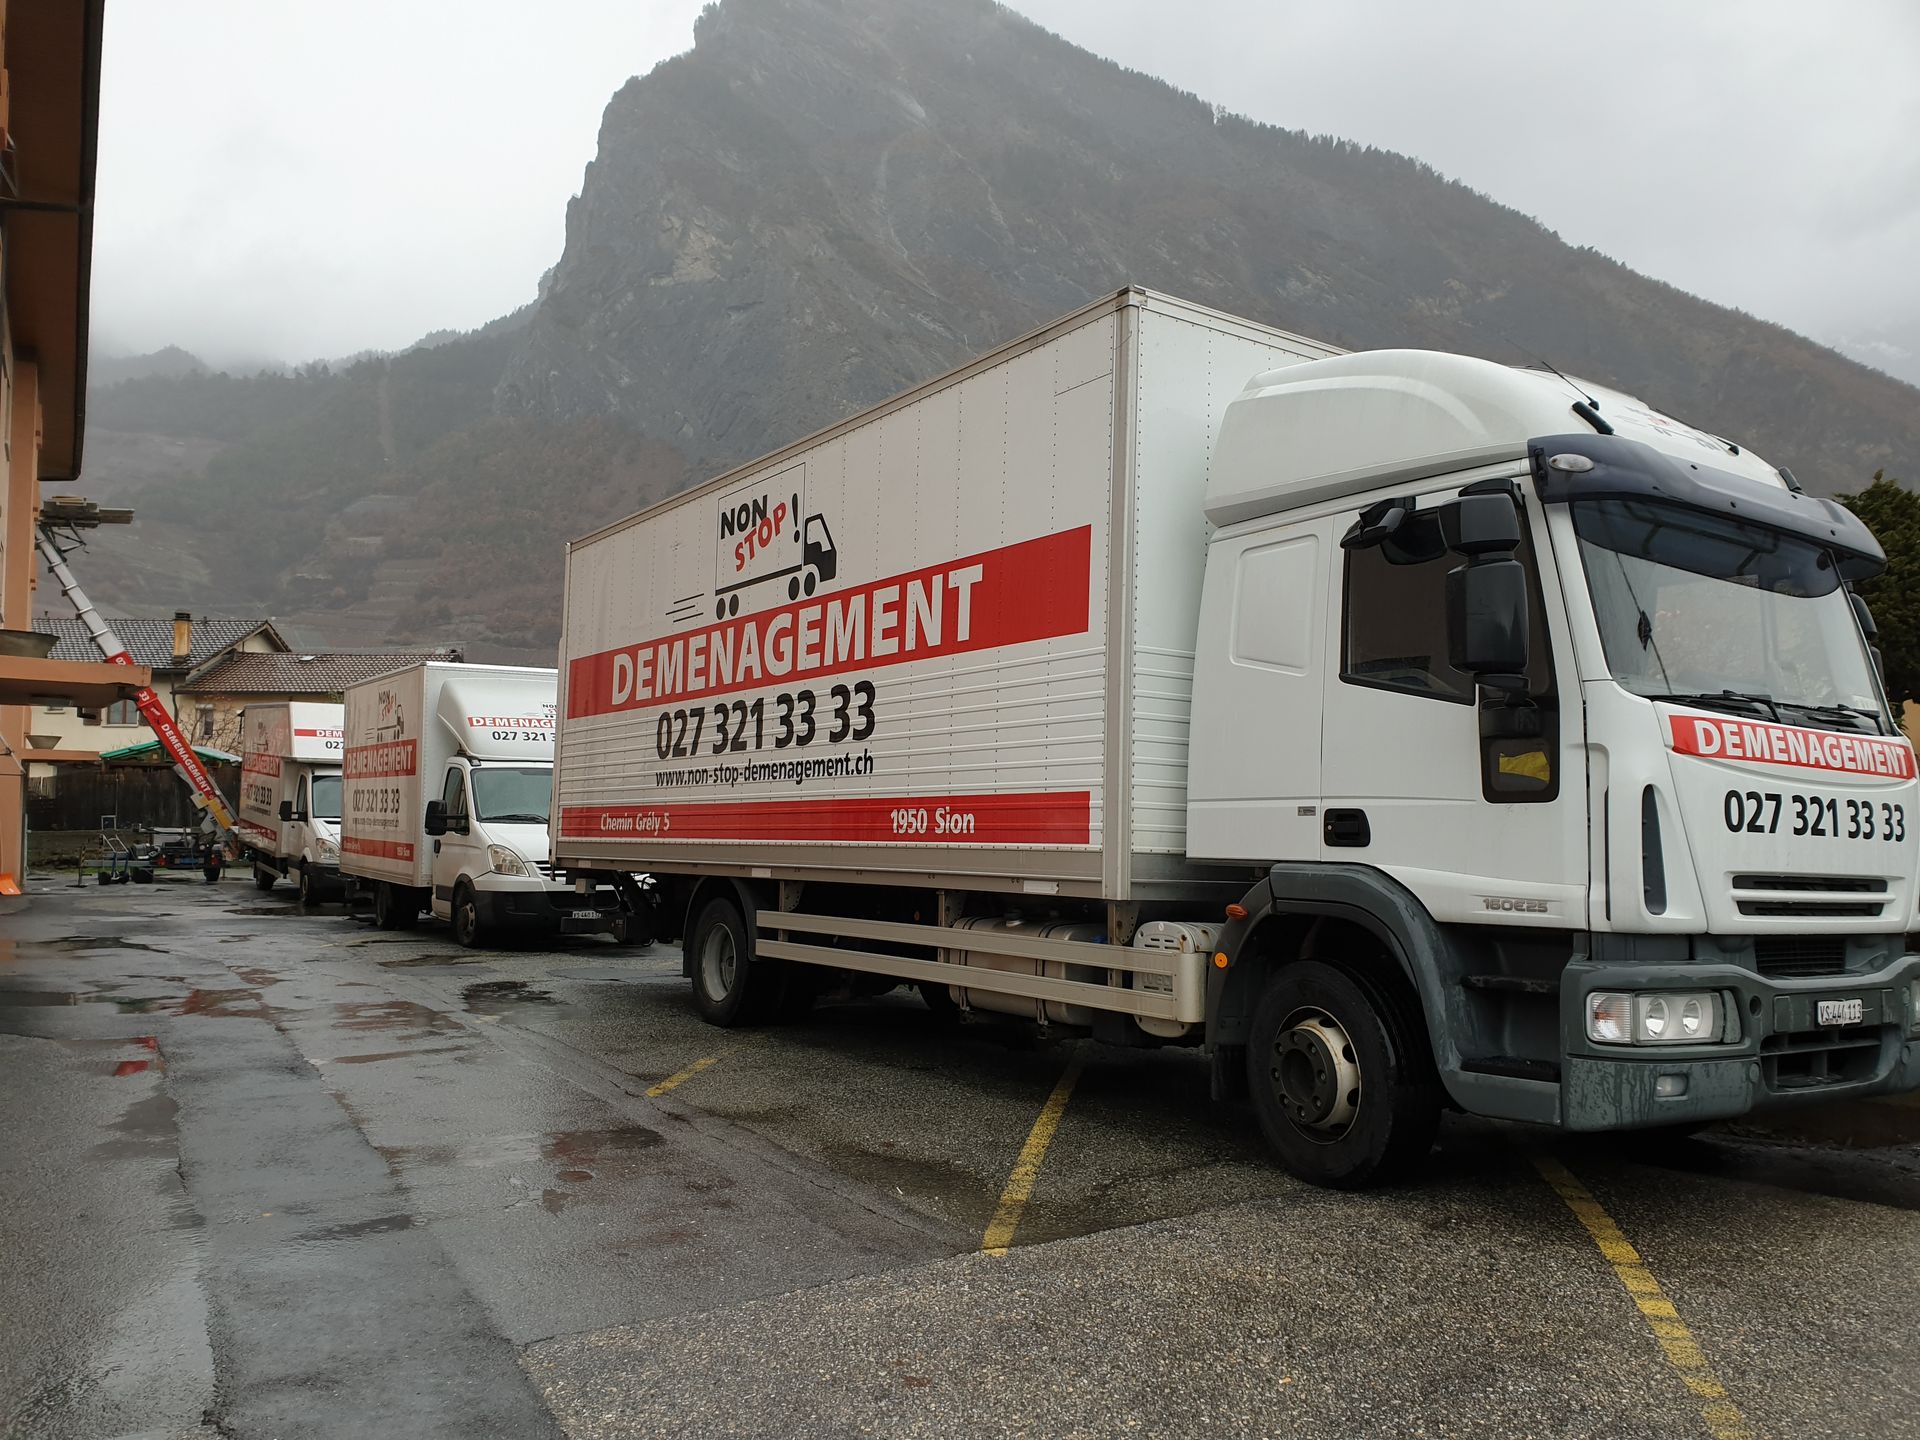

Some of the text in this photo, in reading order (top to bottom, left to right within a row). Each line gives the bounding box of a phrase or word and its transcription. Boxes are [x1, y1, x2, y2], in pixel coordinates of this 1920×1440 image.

[721, 494, 768, 540] NON
[611, 564, 984, 706] DEMENAGEMENT
[492, 731, 518, 741] 027
[522, 732, 547, 742] 321
[656, 680, 876, 760] 027 321 33 33
[161, 723, 211, 793] DEMENAGEMENT
[346, 744, 413, 774] DEMENAGEMENT
[655, 749, 874, 787] www.non-stop-demenagement.ch
[1694, 720, 1909, 777] DEMENAGEMENT
[352, 788, 400, 814] 027 321 33 33
[890, 806, 975, 834] 1950 Sion
[1724, 789, 1906, 842] 027 321 33 33
[600, 811, 670, 836] Chemin Grély 5
